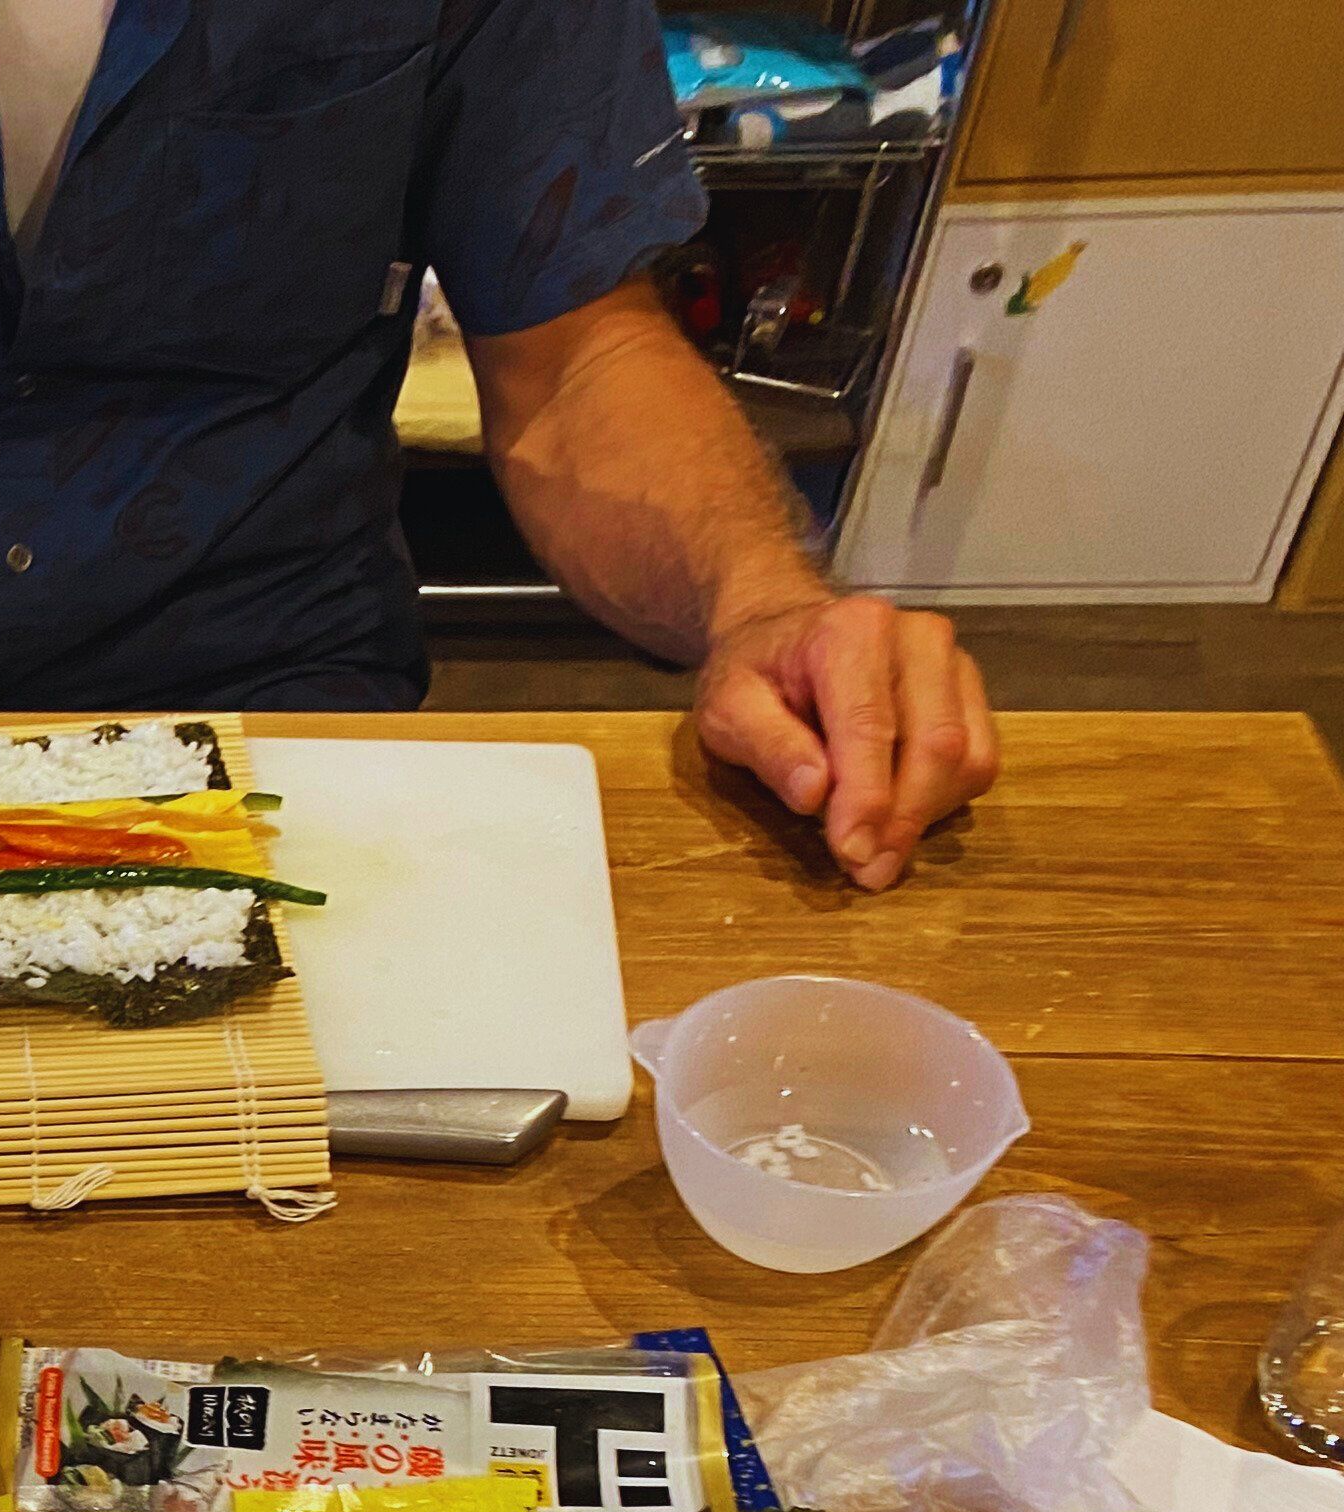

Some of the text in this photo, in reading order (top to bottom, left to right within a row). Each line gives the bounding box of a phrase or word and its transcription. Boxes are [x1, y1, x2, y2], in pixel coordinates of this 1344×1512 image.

[295, 1408, 443, 1432] がたまらない
[293, 1438, 445, 1478] 磯の風味
